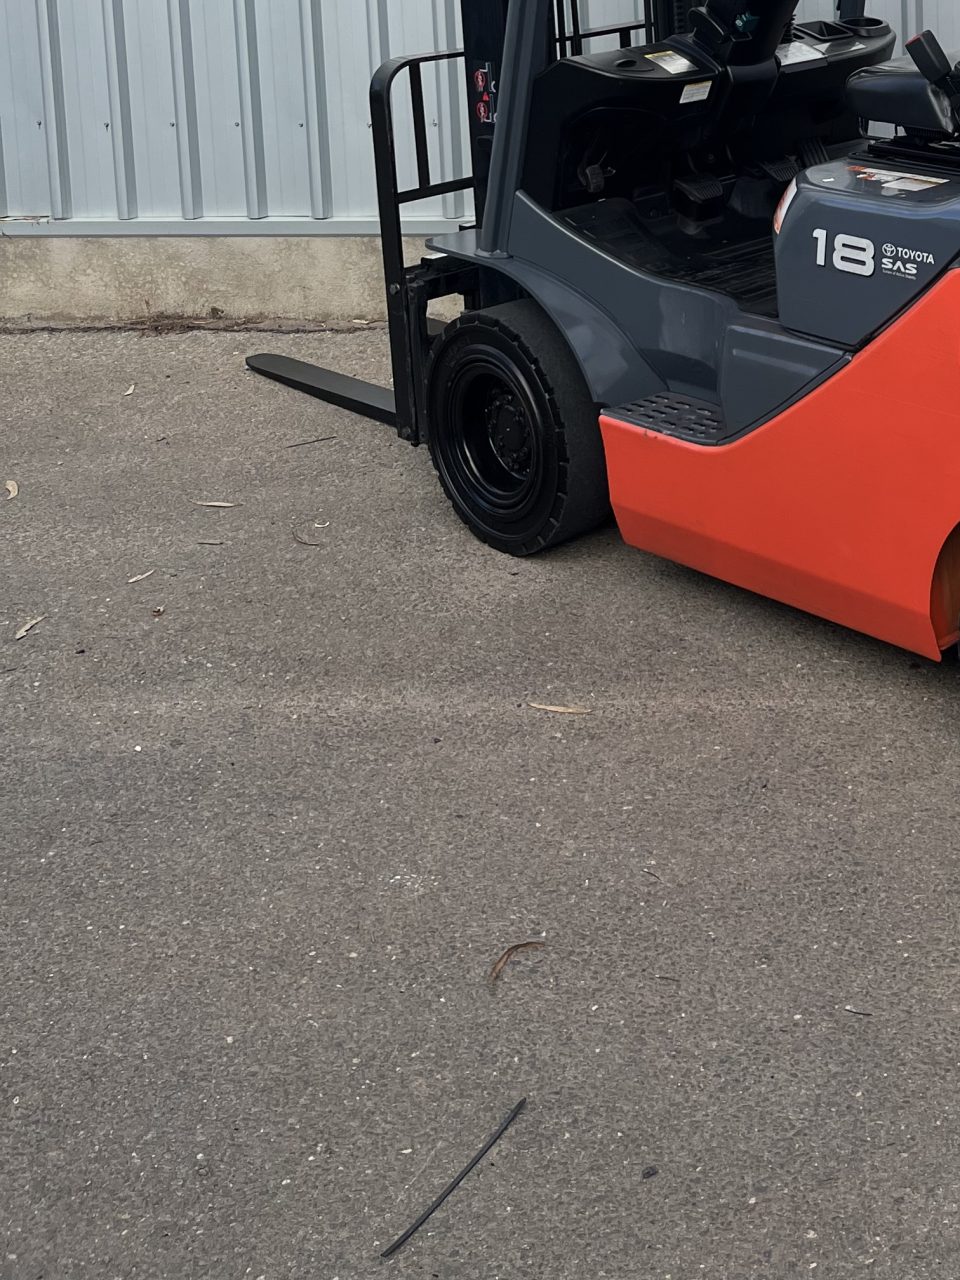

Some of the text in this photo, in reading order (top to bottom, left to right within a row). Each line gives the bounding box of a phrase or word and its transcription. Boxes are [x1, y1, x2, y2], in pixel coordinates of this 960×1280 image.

[812, 228, 875, 276] 18
[897, 247, 935, 264] TOYOTA
[881, 258, 917, 274] SAS
